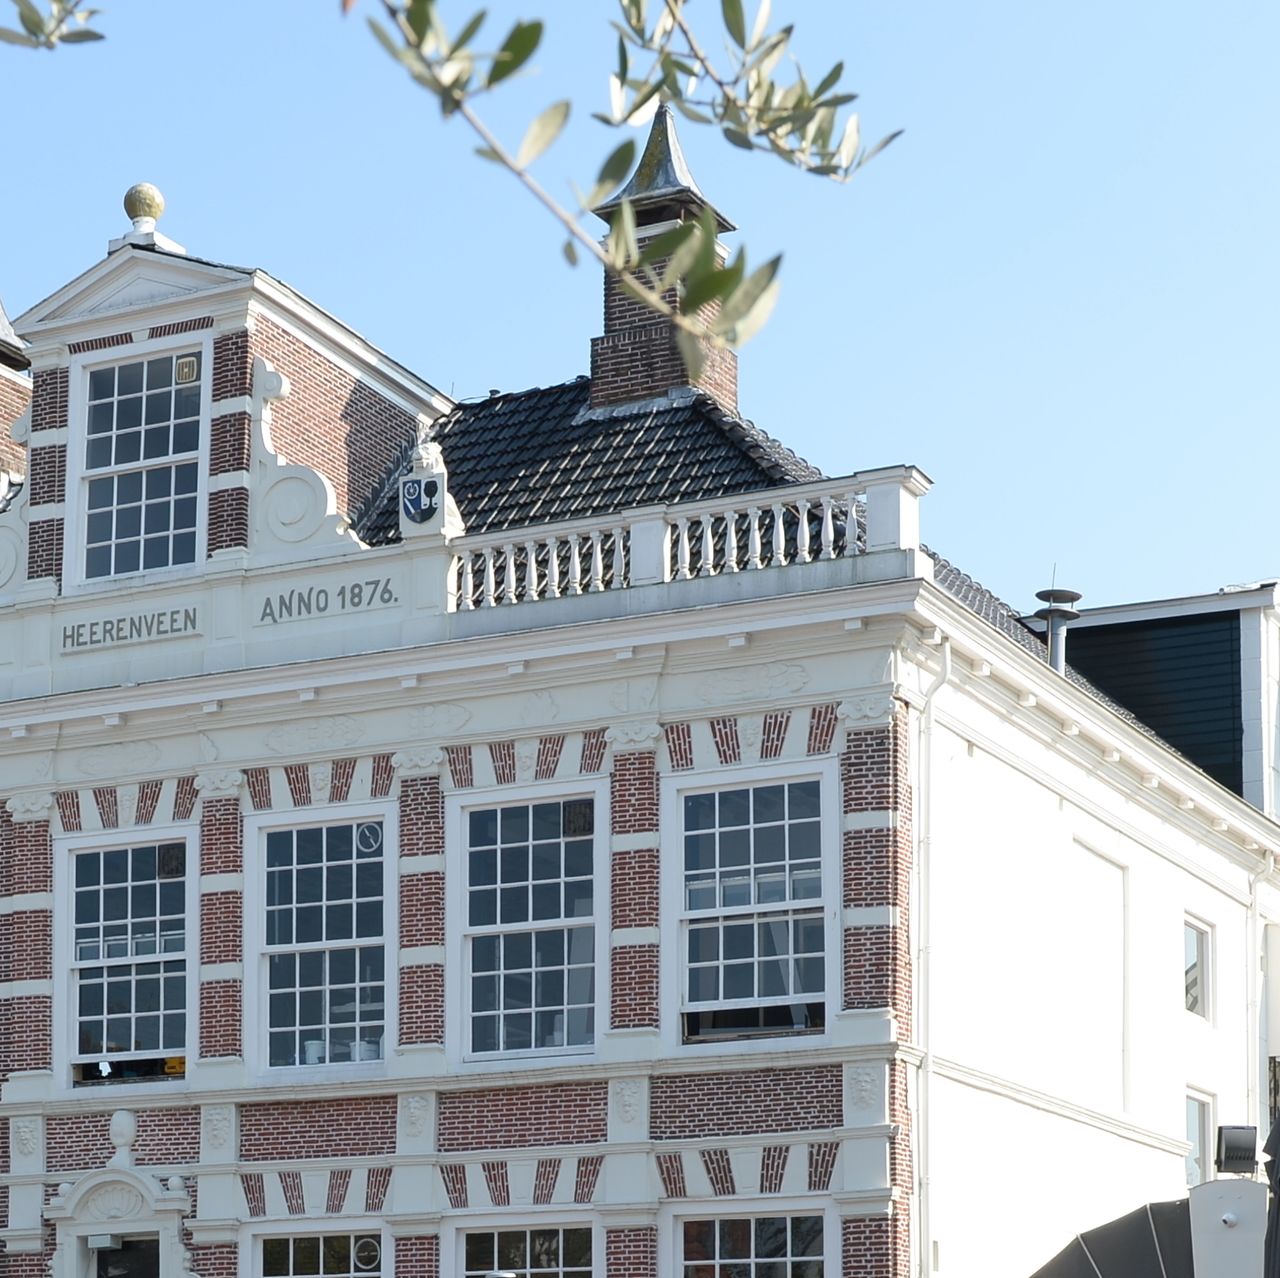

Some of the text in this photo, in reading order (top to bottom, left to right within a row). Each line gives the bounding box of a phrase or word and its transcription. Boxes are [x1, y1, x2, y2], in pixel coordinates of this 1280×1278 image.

[260, 578, 399, 623] ANNO 1876.
[63, 607, 197, 649] HEERENVEEN
